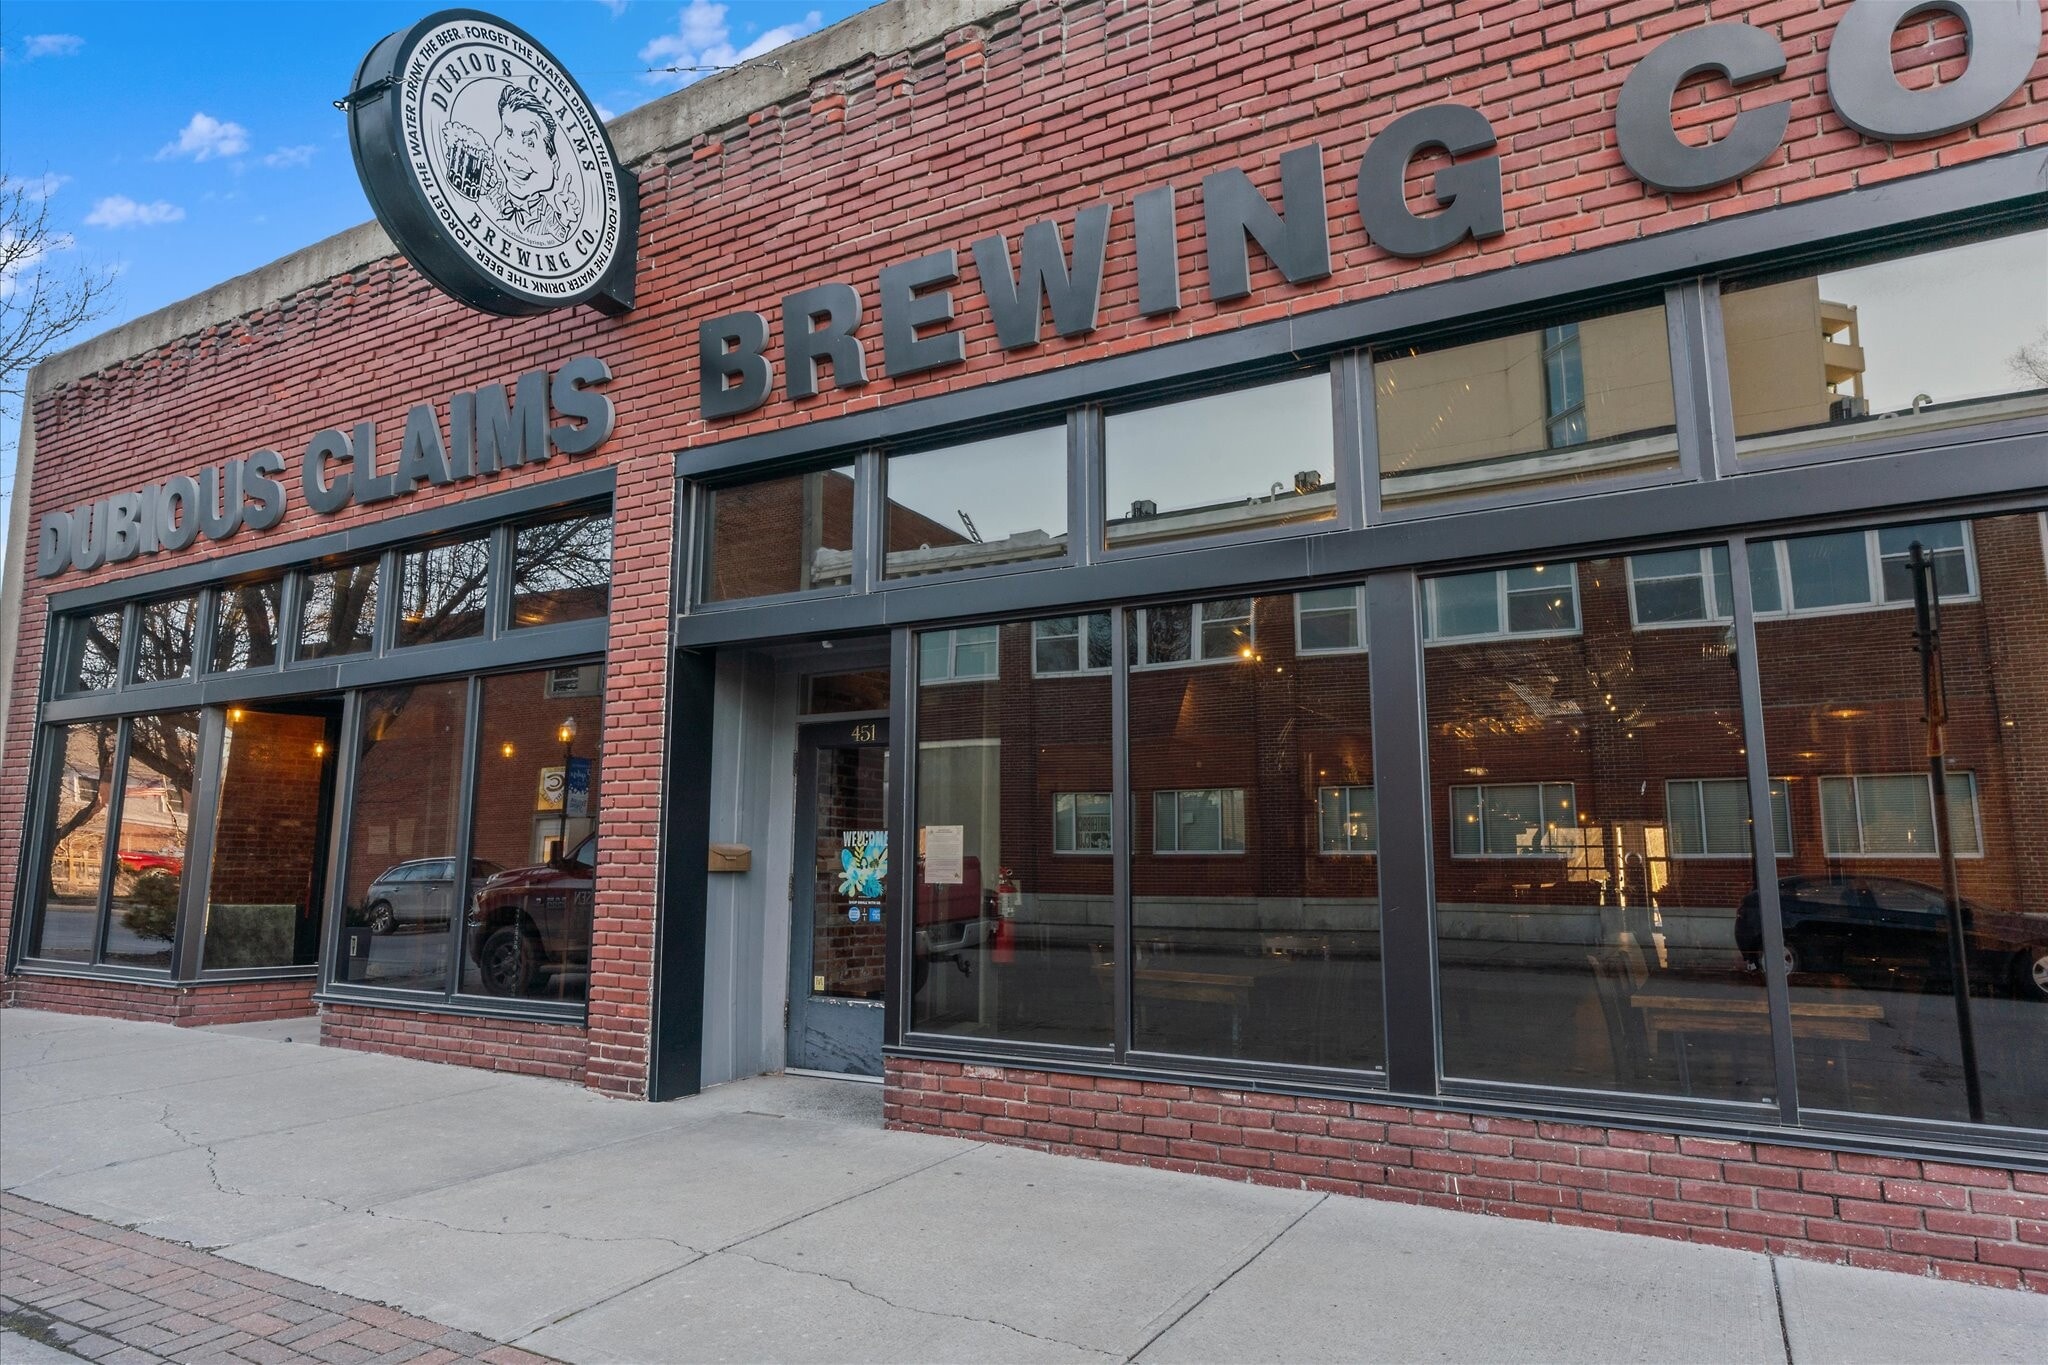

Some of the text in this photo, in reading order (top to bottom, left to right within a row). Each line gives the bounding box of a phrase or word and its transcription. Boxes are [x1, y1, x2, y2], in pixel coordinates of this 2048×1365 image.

[419, 40, 438, 61] THE
[406, 58, 426, 102] DRINK
[464, 26, 508, 46] FORGET
[512, 39, 532, 60] THE
[536, 56, 570, 96] WATER
[571, 97, 598, 140] DRINK
[596, 143, 610, 167] THE
[406, 104, 422, 156] WATER
[431, 52, 596, 172] DUBIOUS CLAIMS
[416, 162, 434, 190] THE
[430, 194, 472, 248] FORGET
[604, 207, 617, 254] FORGET
[698, 0, 2043, 420] BREWING CO
[468, 212, 598, 272] BREWING CO.
[594, 252, 608, 271] THE
[508, 271, 528, 288] THE
[532, 280, 566, 294] DRINK
[567, 267, 598, 290] WATER
[37, 356, 616, 578] DUBIOUS CLAIMS
[851, 724, 876, 742] 451
